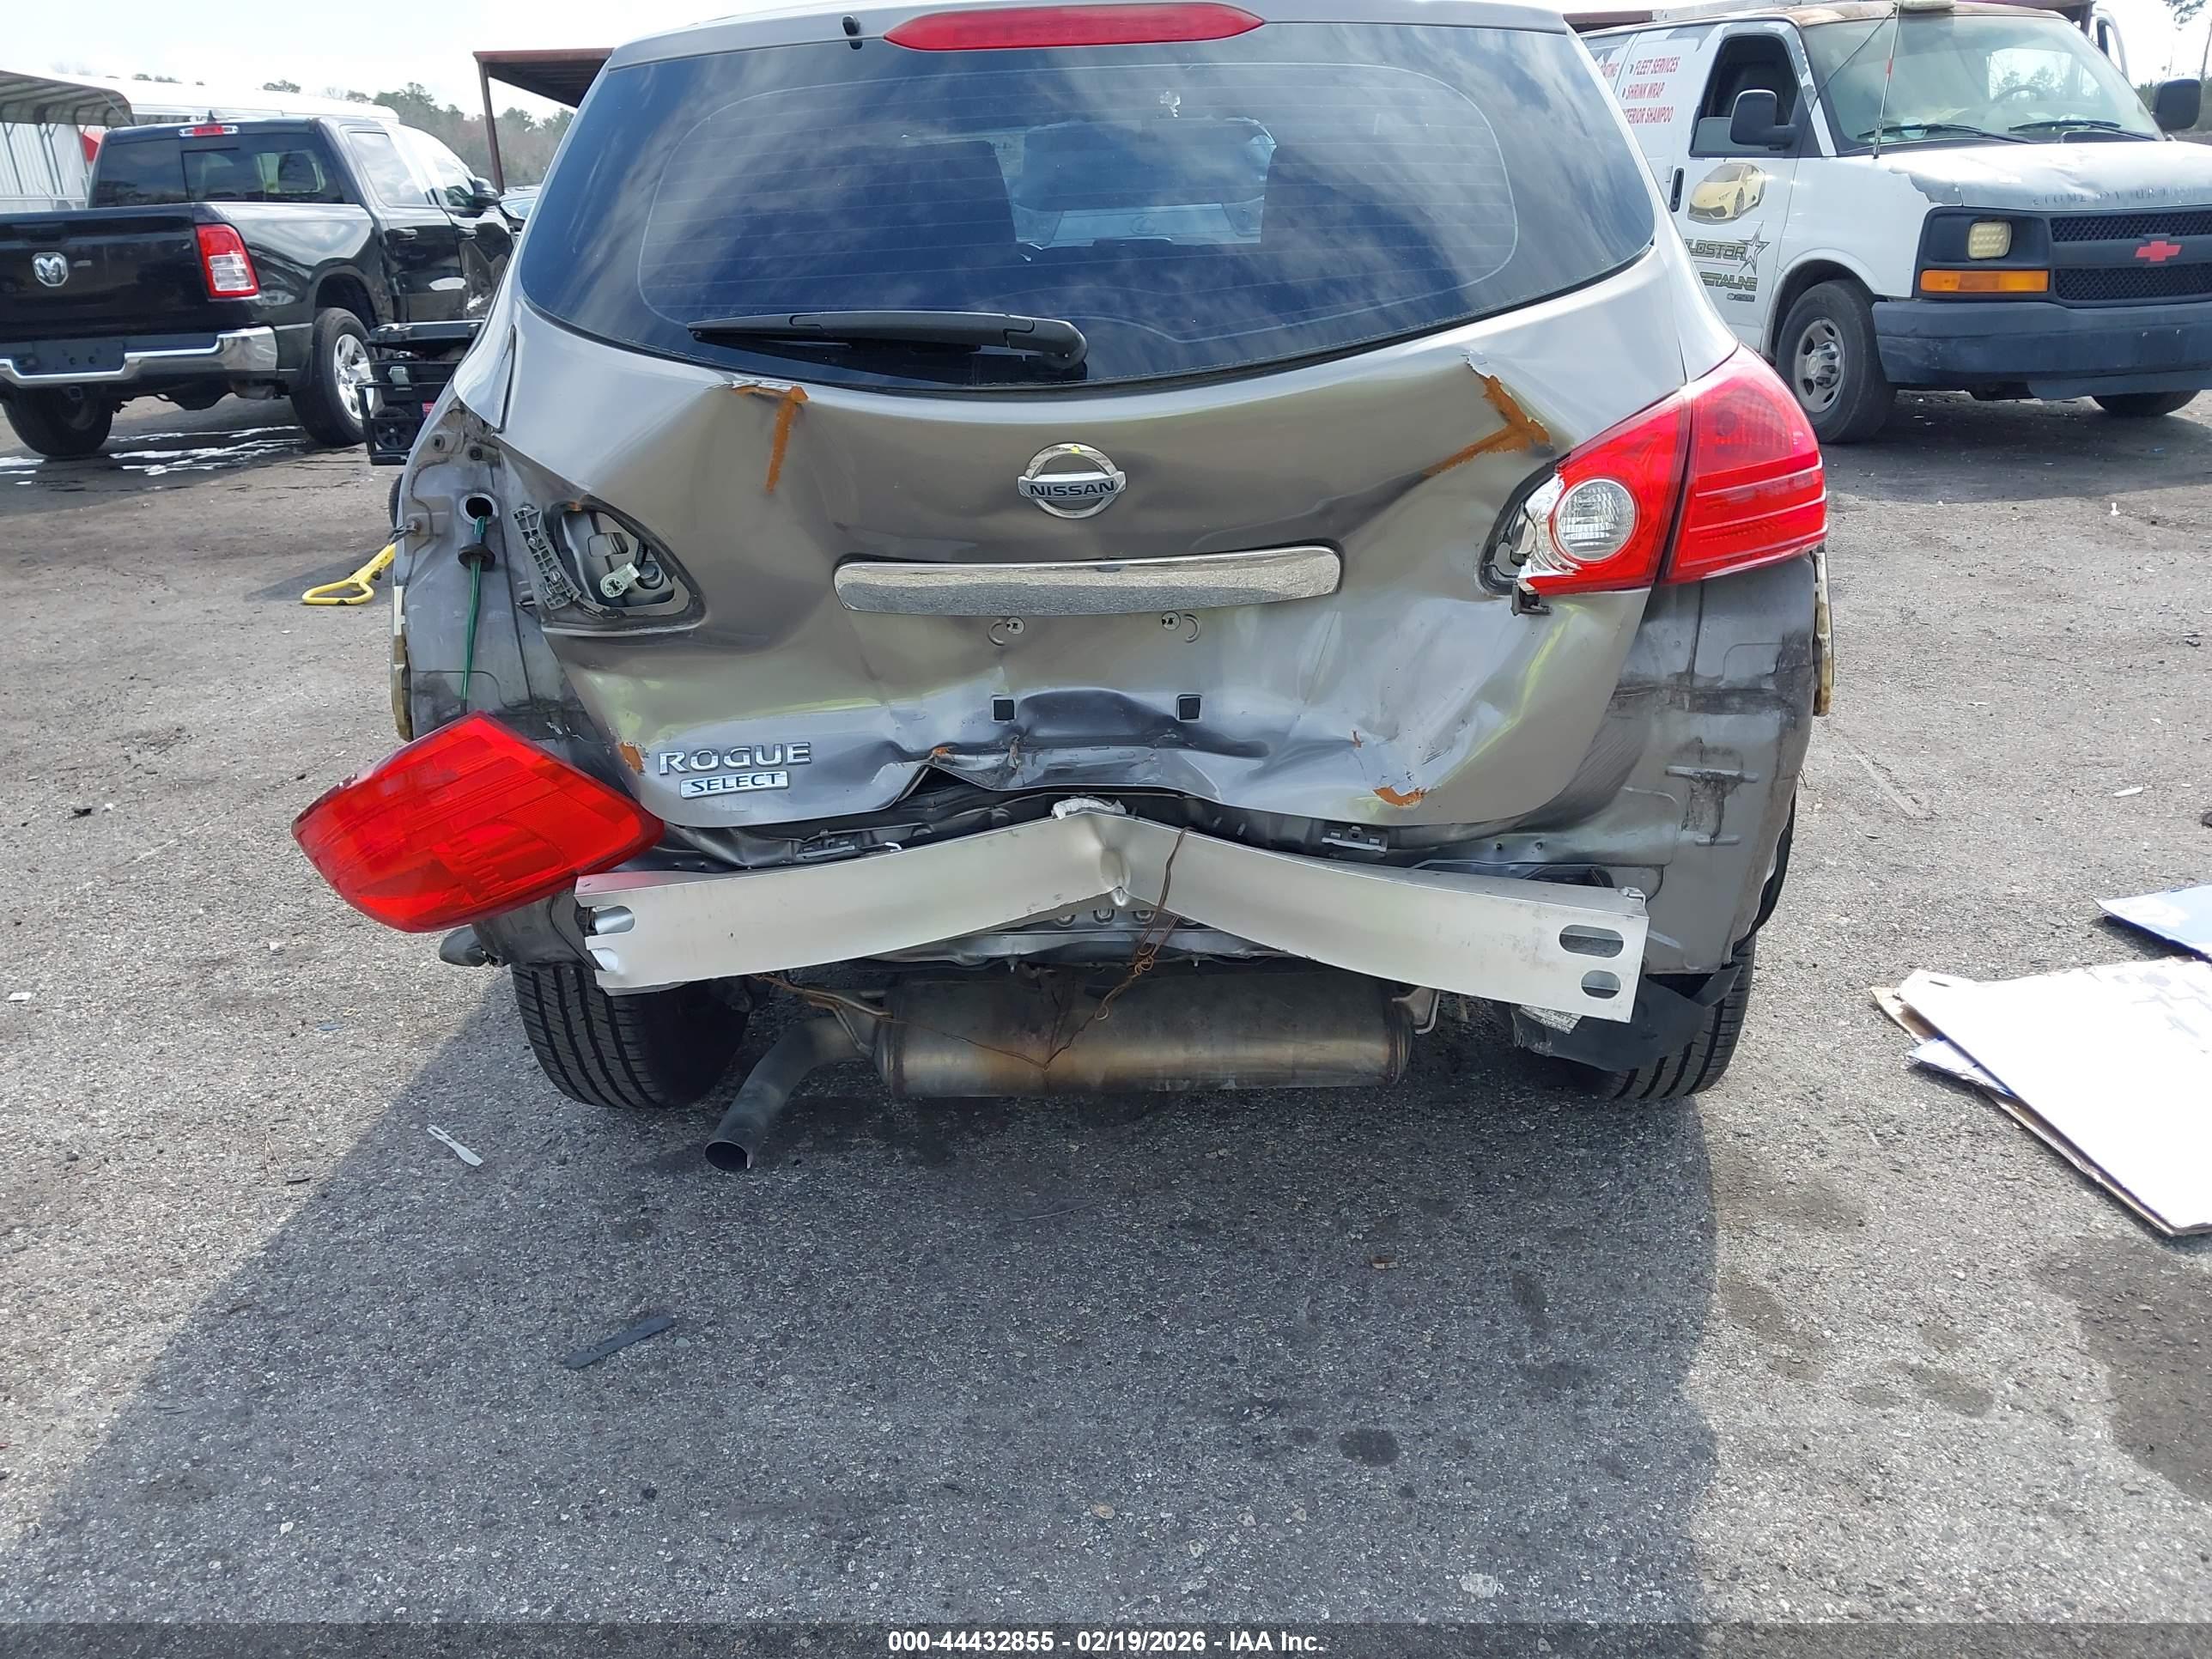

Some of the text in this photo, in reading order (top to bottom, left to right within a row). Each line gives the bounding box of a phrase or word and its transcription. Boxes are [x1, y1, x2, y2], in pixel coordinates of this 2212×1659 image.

[1633, 56, 1680, 76] FLEET SERVICES
[1625, 82, 1665, 100] SHRINK WRAP
[1644, 106, 1674, 124] SHAMPOO
[1030, 480, 1115, 496] NISSAN
[659, 741, 812, 775] ROGUE
[690, 773, 781, 793] SELECT
